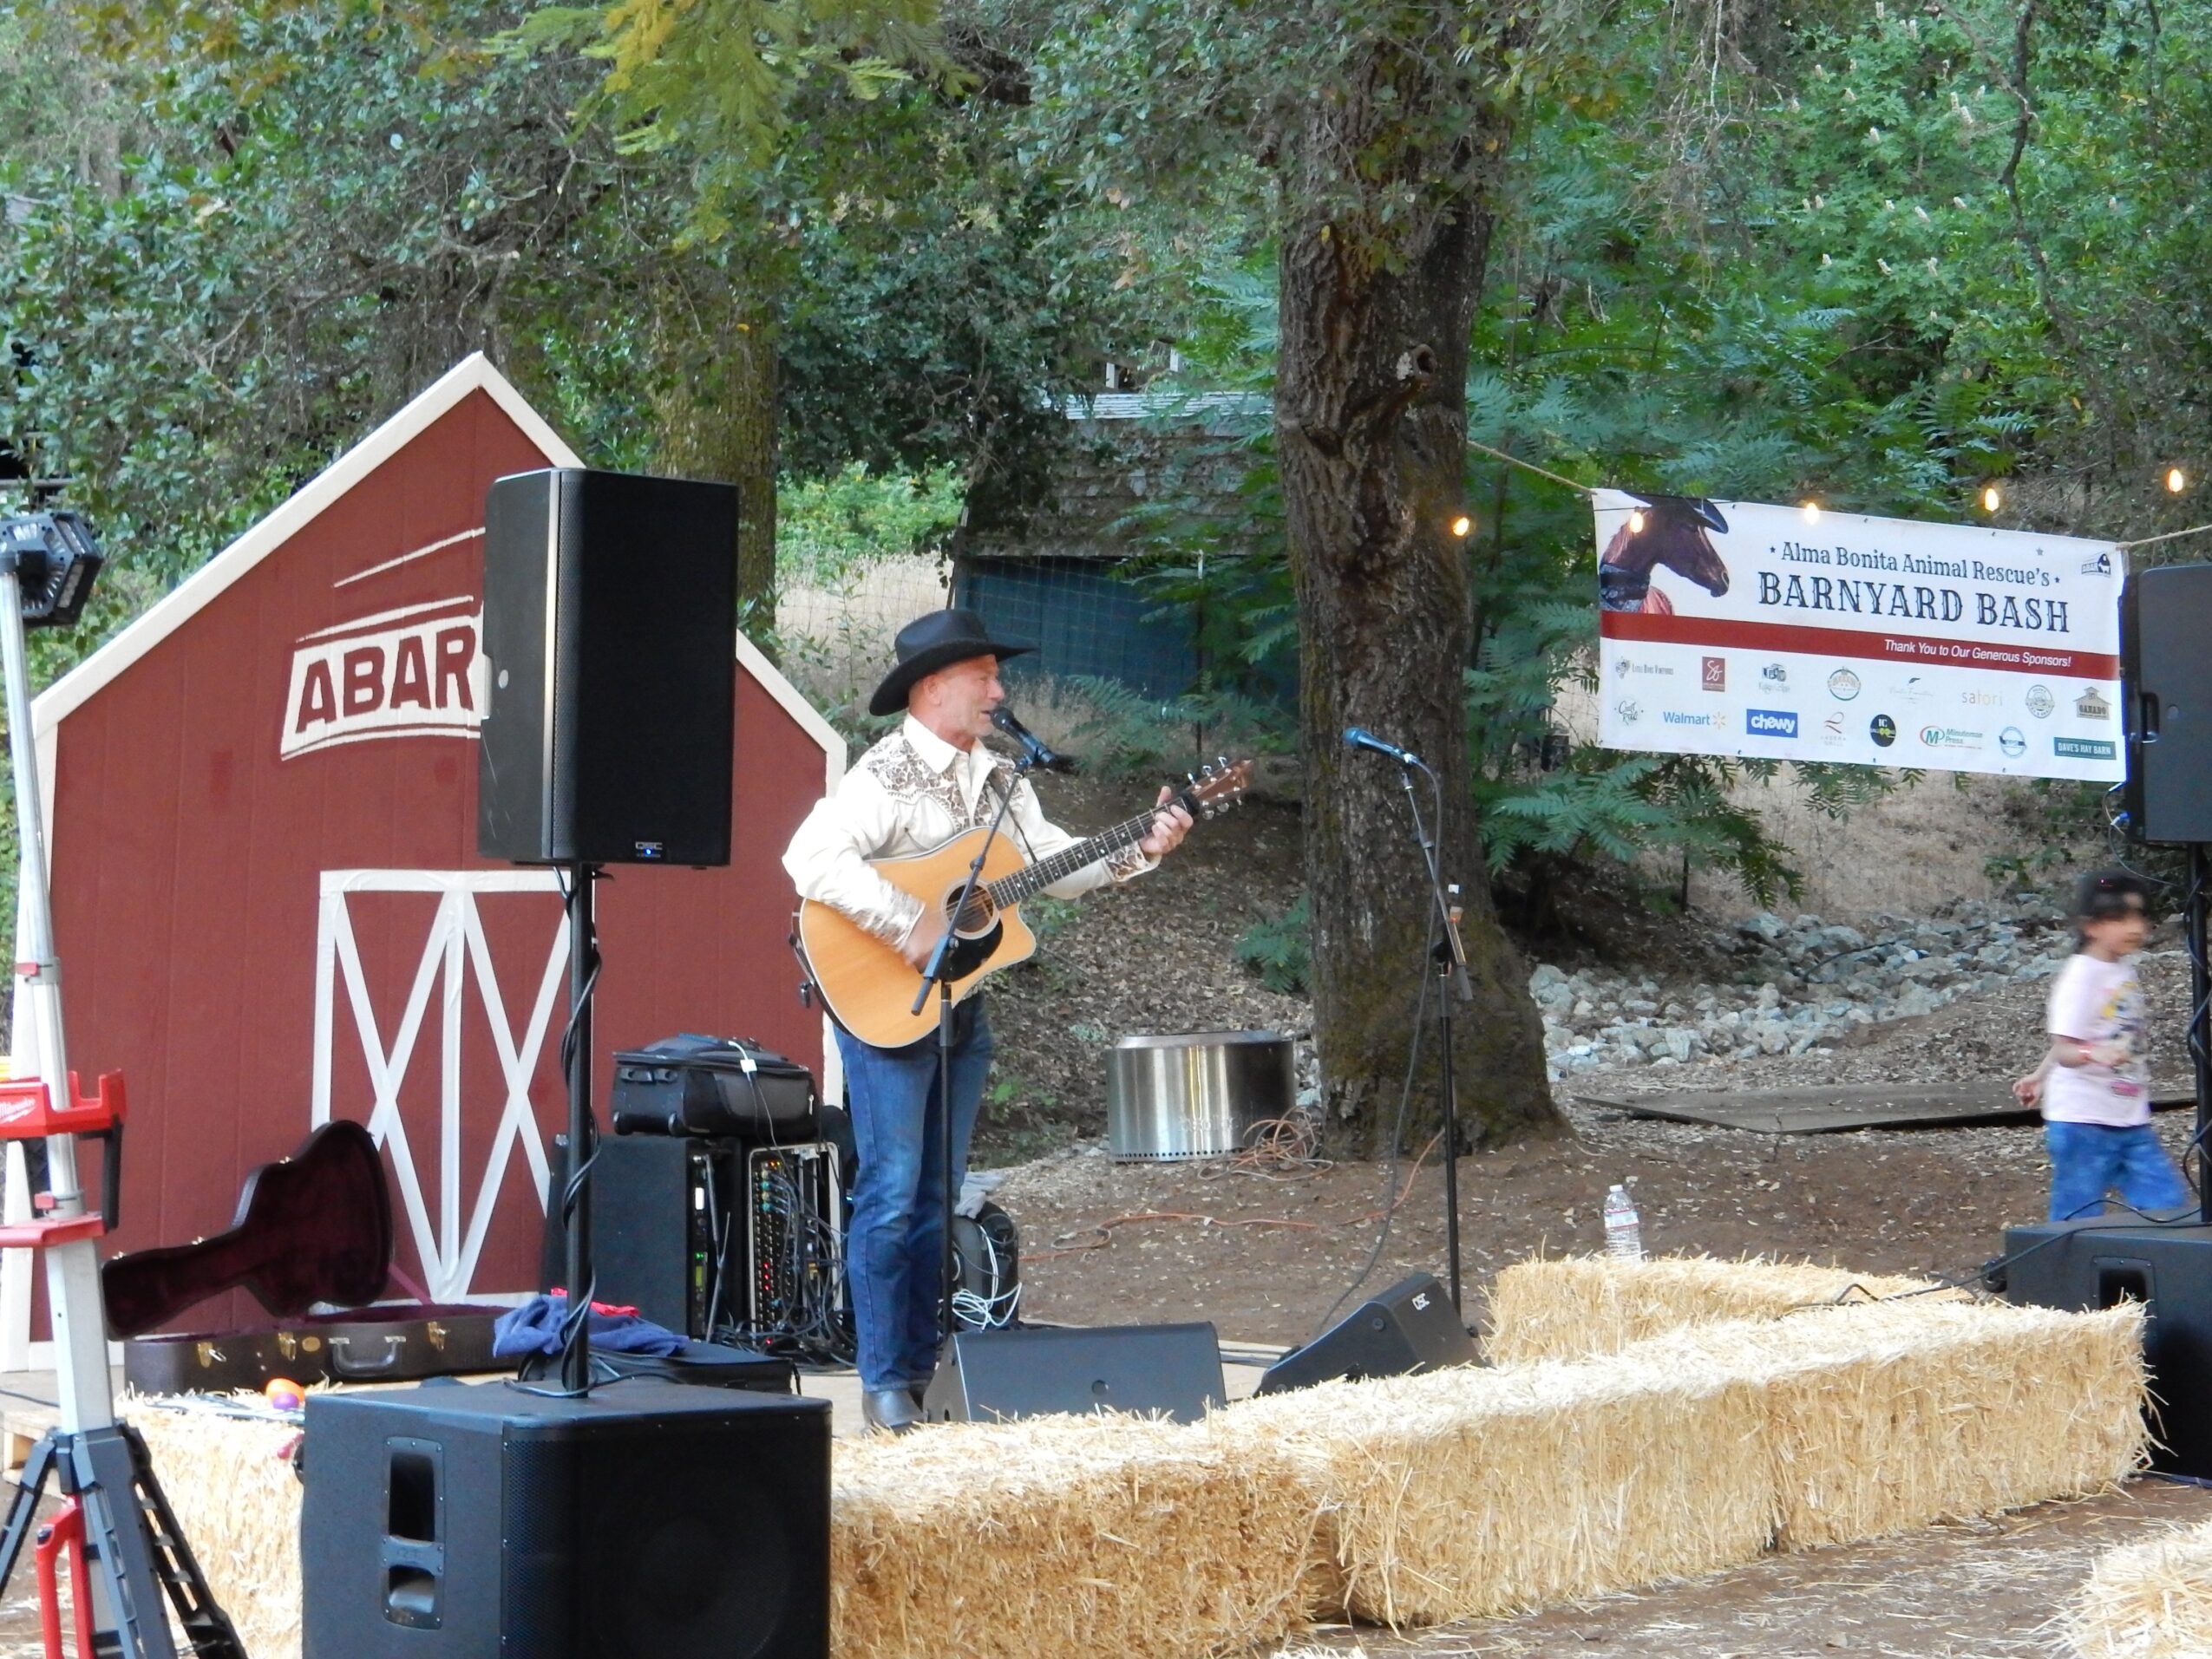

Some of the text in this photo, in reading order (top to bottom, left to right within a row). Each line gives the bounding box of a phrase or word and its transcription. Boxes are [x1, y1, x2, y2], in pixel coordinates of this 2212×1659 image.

[1781, 541, 2051, 587] Alma Bonita Animal Rescue's
[1758, 572, 2071, 633] BARNYARD BASH
[1884, 639, 2071, 667] Thank You to Our Generous Sponsors!
[295, 624, 476, 735] ABAR
[1663, 711, 1711, 726] Walmart
[1751, 713, 1796, 734] chewy
[2058, 742, 2111, 755] DAVE'S HAY BARN
